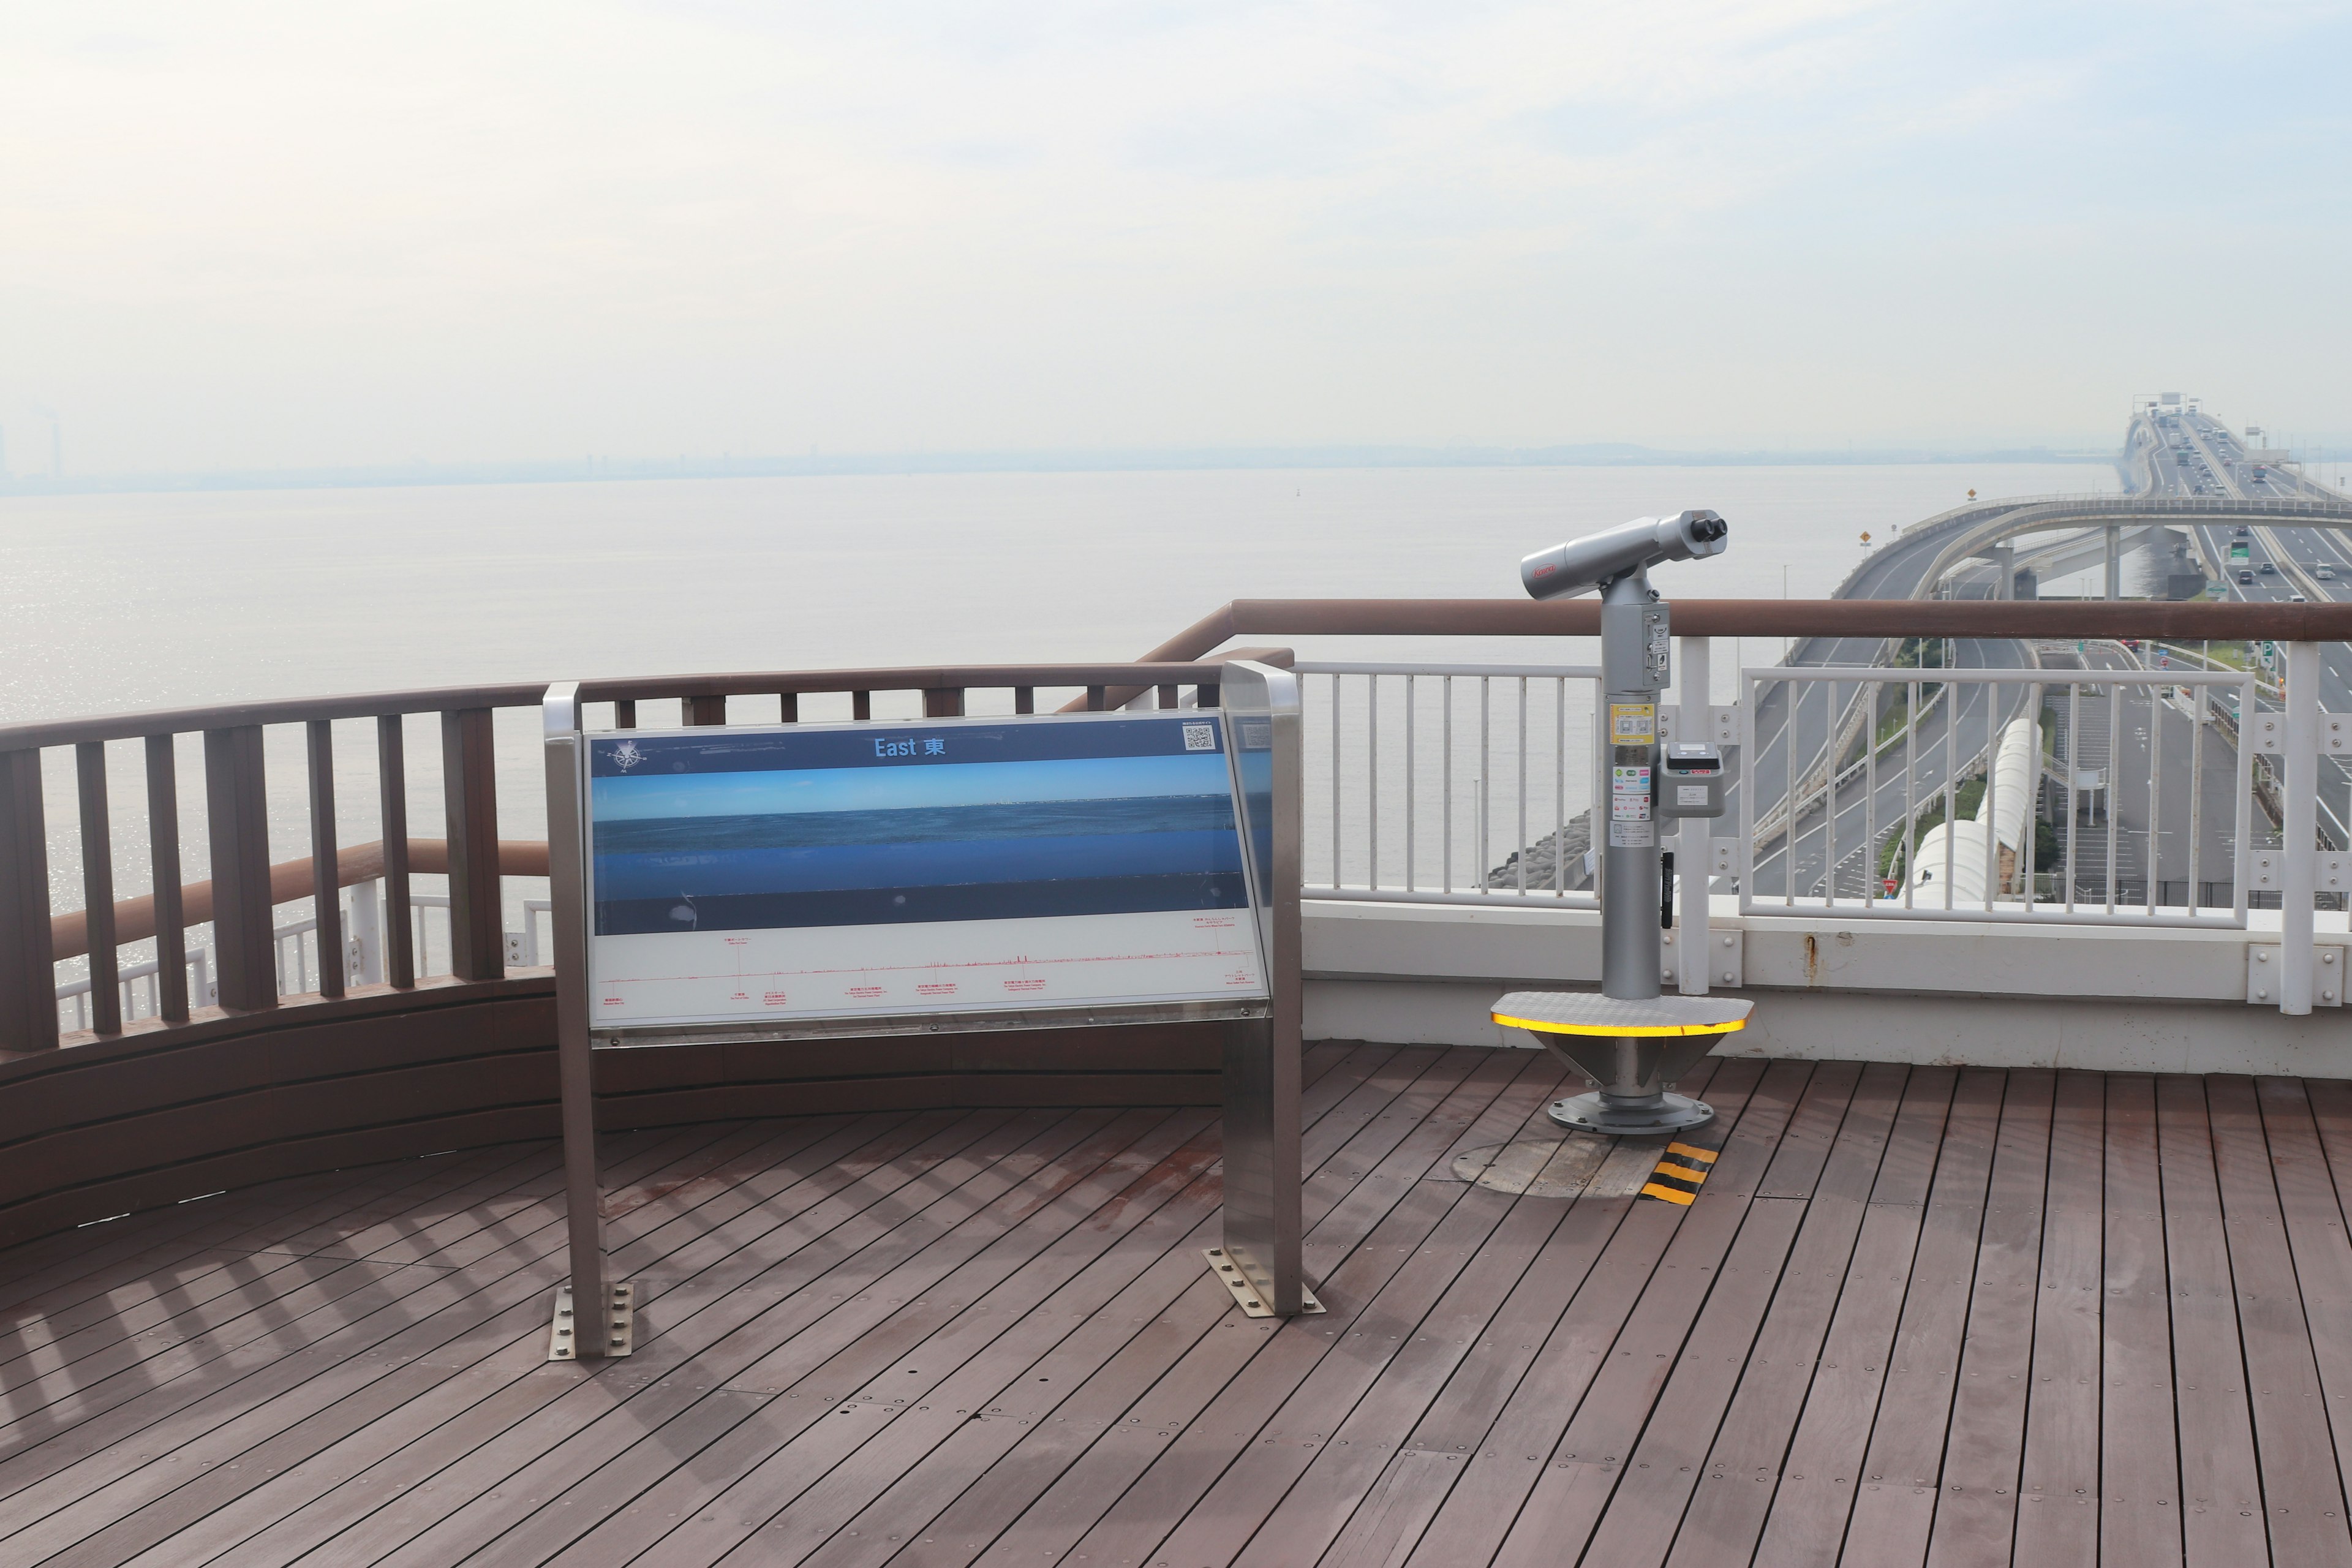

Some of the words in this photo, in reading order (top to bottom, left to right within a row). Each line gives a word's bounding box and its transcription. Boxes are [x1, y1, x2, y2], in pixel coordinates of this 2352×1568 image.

[1534, 565, 1555, 578] Kowa
[2264, 643, 2272, 655] P
[875, 738, 916, 757] East
[924, 738, 946, 755] 東
